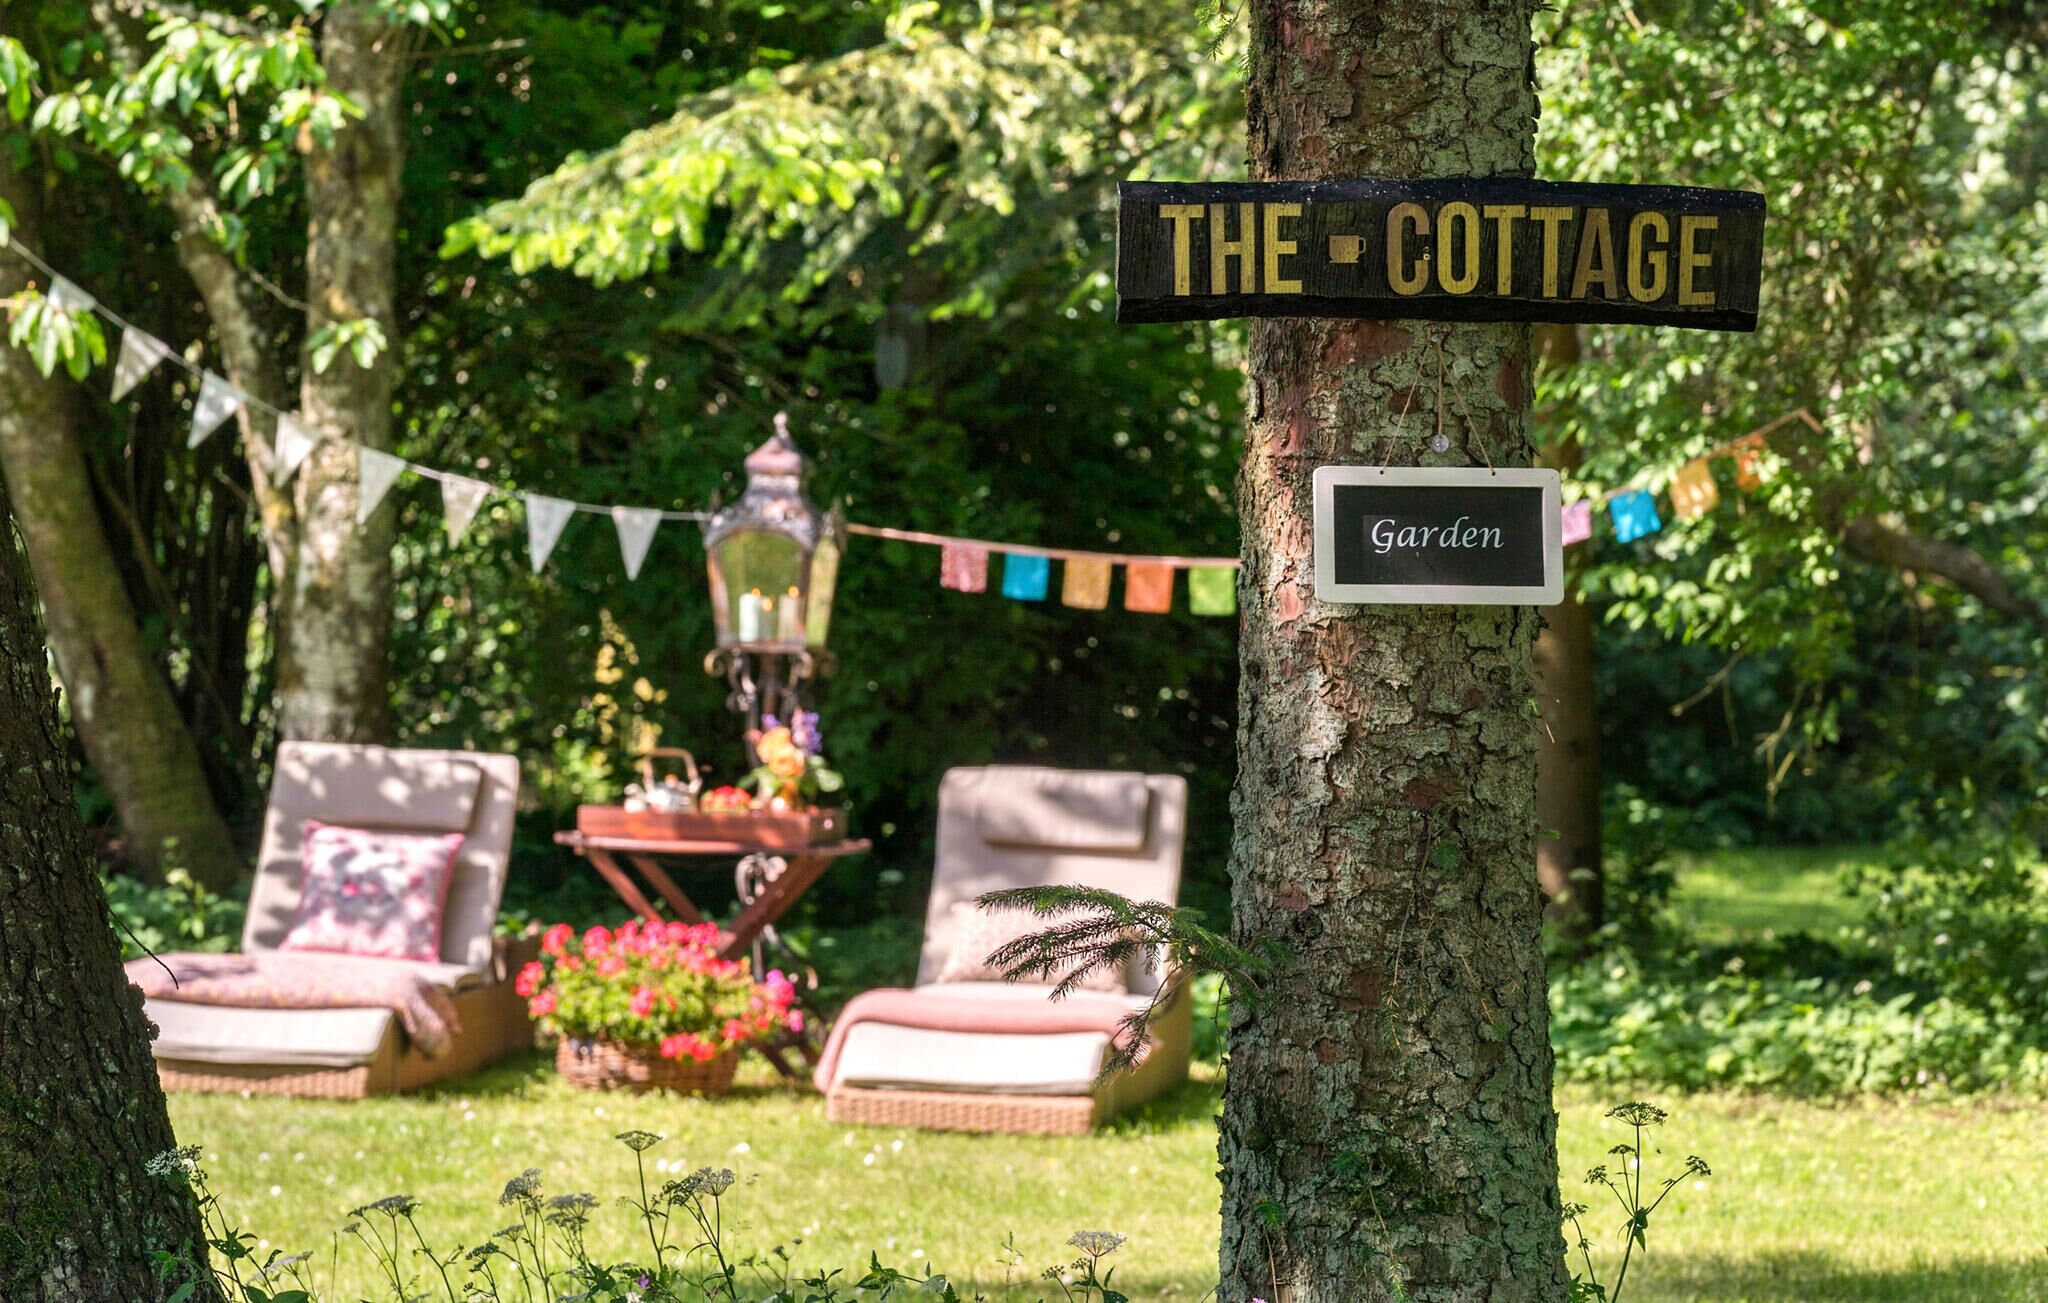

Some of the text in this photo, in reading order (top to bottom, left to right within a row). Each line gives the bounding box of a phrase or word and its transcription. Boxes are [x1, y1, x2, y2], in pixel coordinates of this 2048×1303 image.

[1158, 201, 1719, 306] THE COTTAGE
[1371, 516, 1505, 554] Garden
